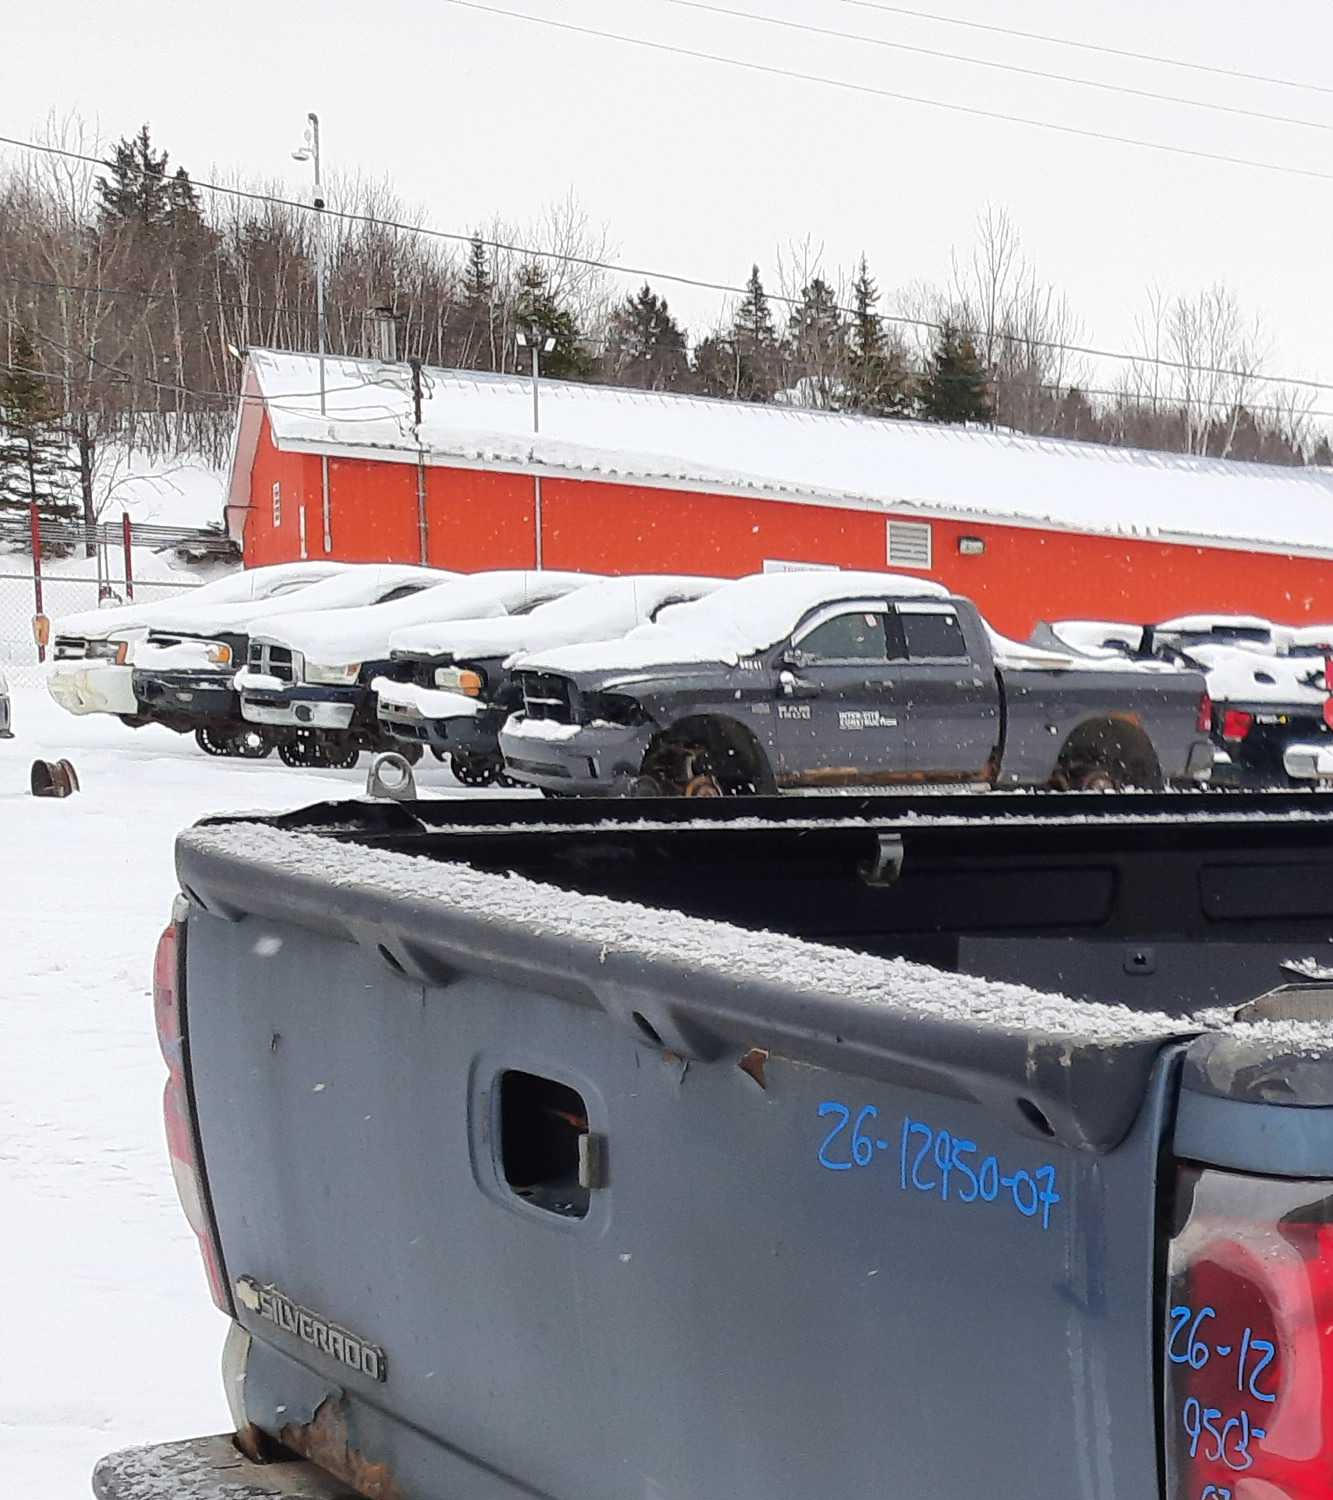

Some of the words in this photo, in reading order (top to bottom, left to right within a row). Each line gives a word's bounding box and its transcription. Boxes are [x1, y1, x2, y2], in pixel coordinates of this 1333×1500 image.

[816, 1100, 1062, 1231] 26-12950-07
[259, 1291, 380, 1382] SILVERADO
[1168, 1305, 1276, 1403] 26-12
